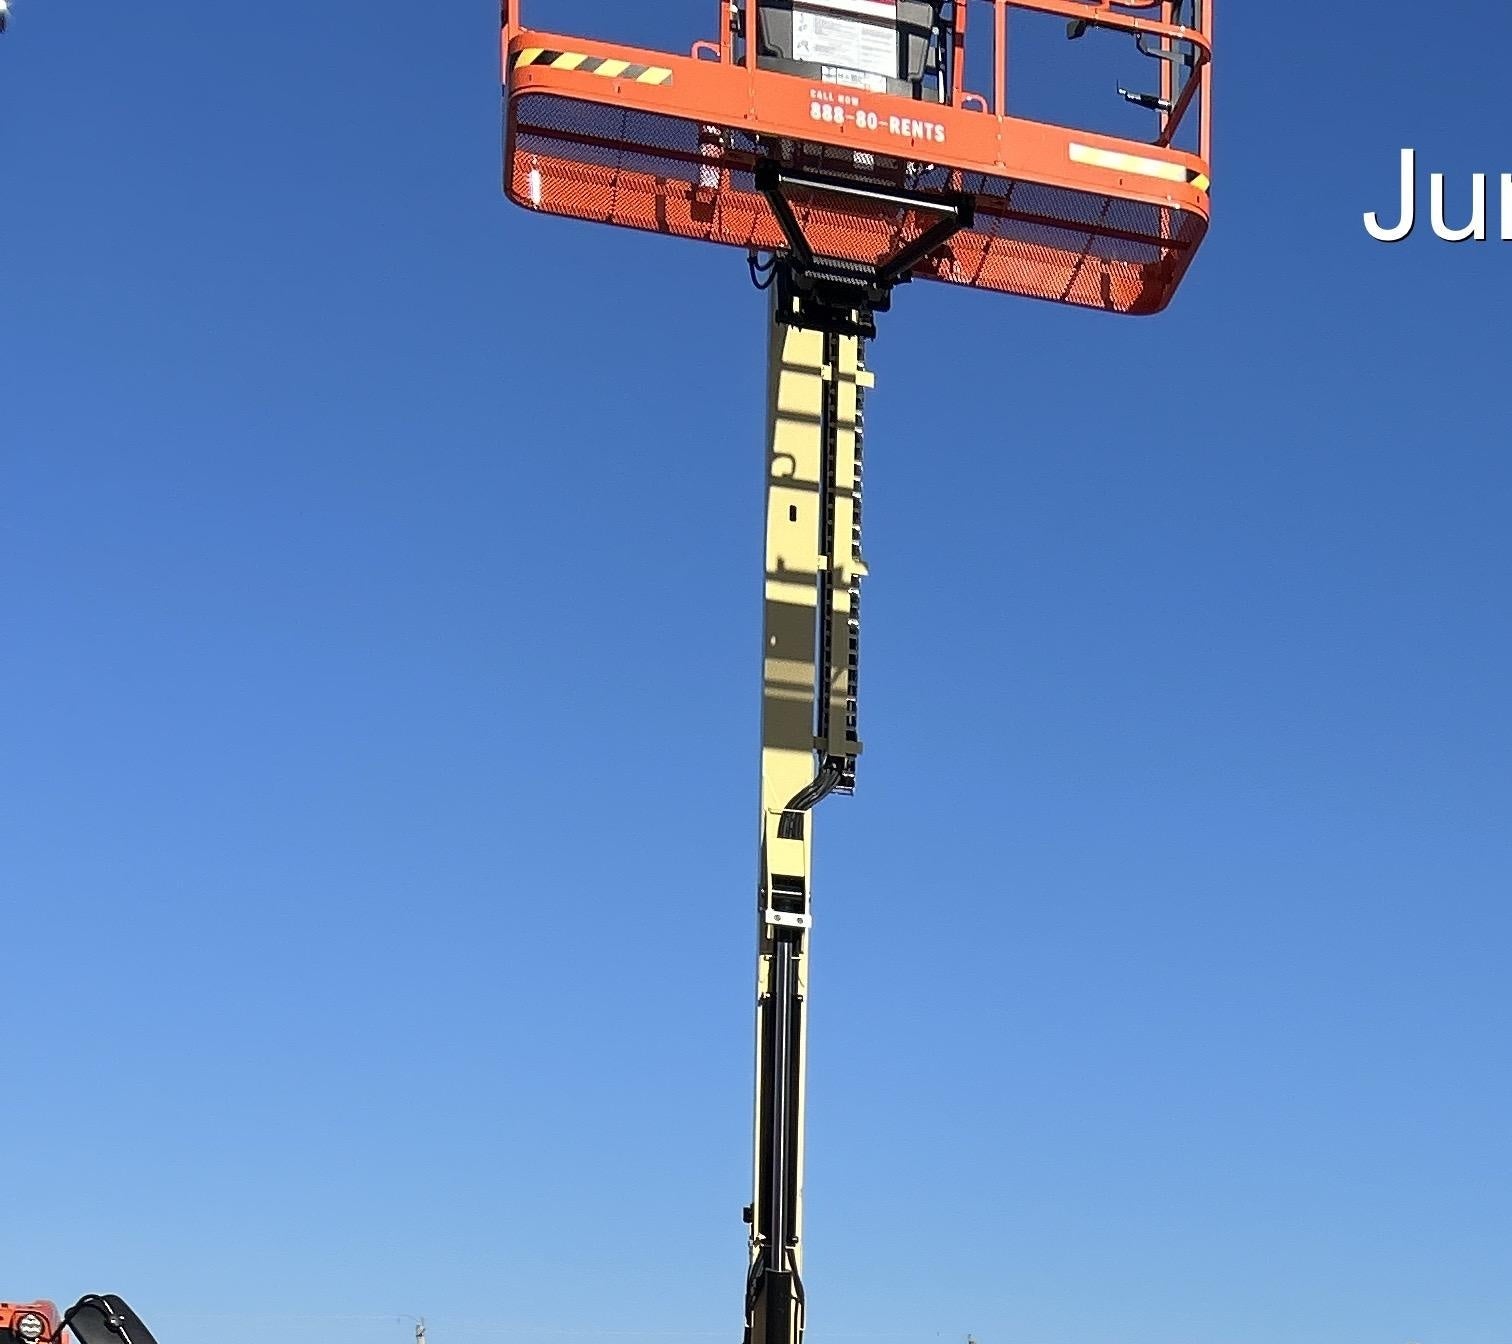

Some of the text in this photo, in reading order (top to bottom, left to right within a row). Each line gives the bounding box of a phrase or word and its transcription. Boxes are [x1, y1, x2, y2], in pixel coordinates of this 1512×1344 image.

[810, 88, 859, 107] CALL NOW
[810, 102, 945, 142] 888-80-RENTS
